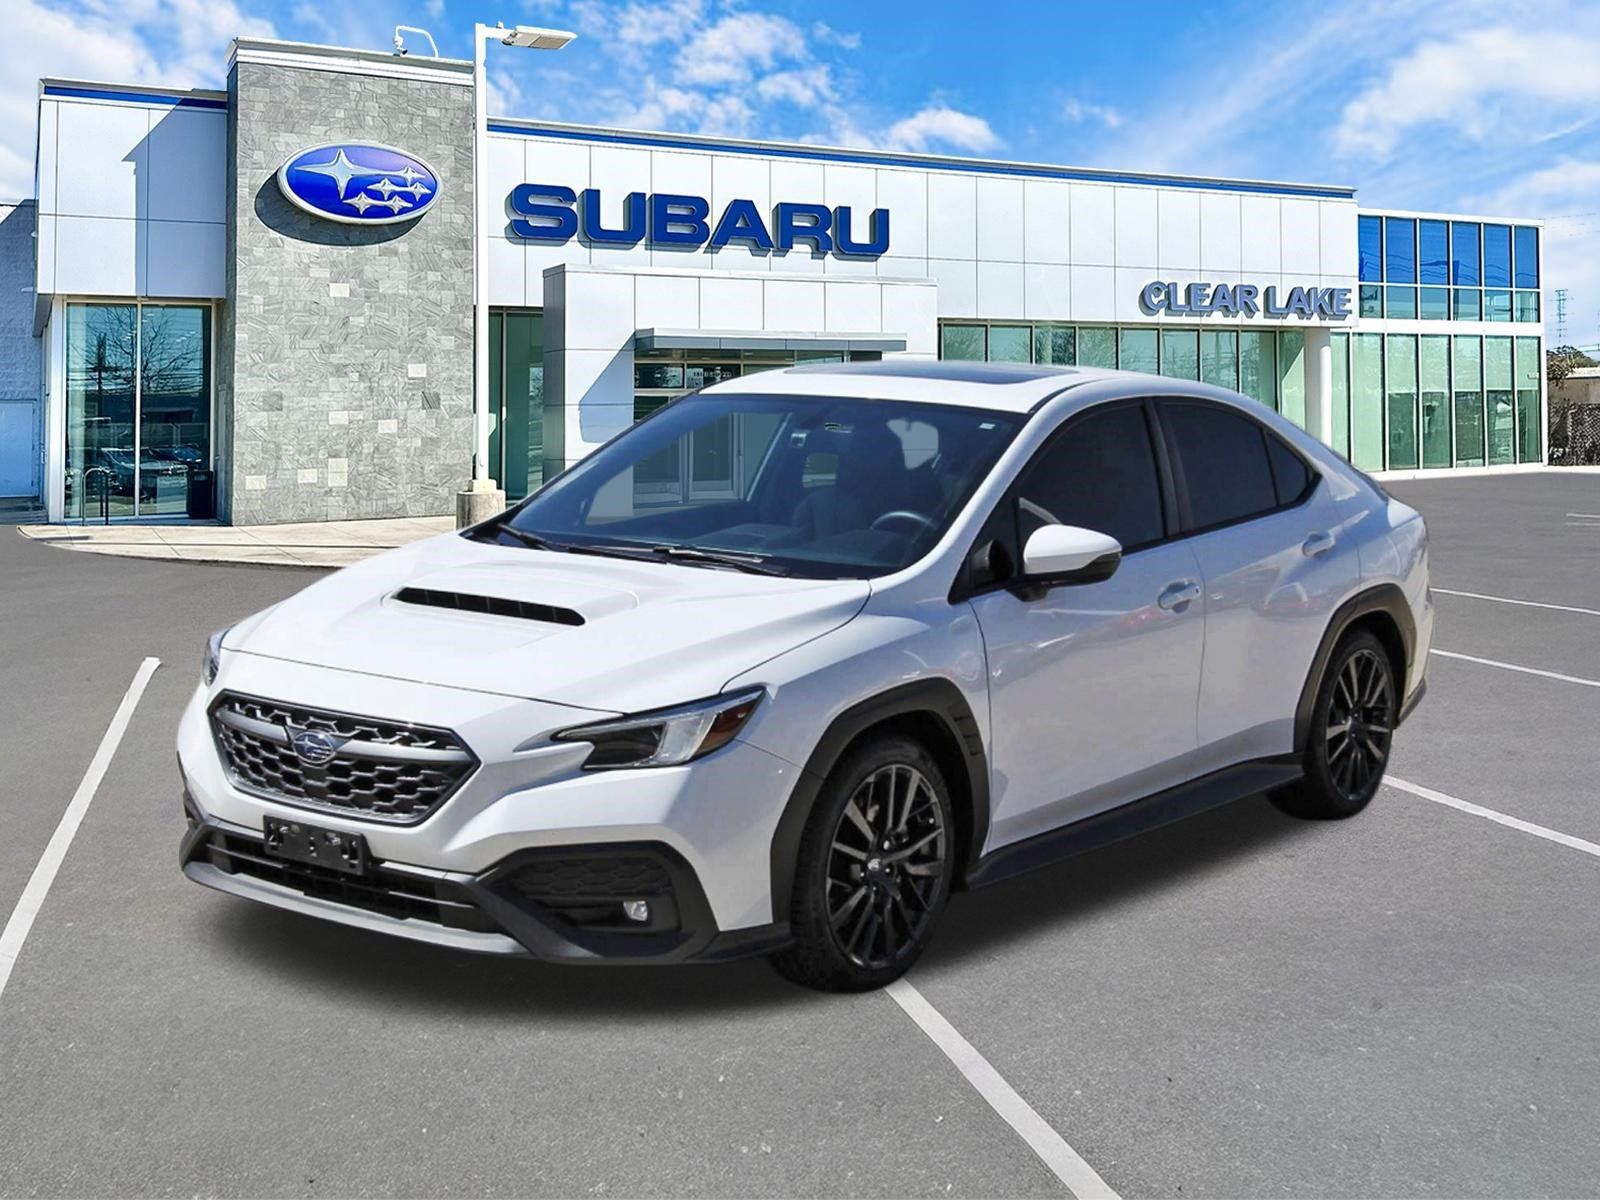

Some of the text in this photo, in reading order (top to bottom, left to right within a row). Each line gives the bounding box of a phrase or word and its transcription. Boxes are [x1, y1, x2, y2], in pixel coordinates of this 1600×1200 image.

[506, 183, 890, 260] SUBARU
[1140, 281, 1353, 319] CLEAR LAKE
